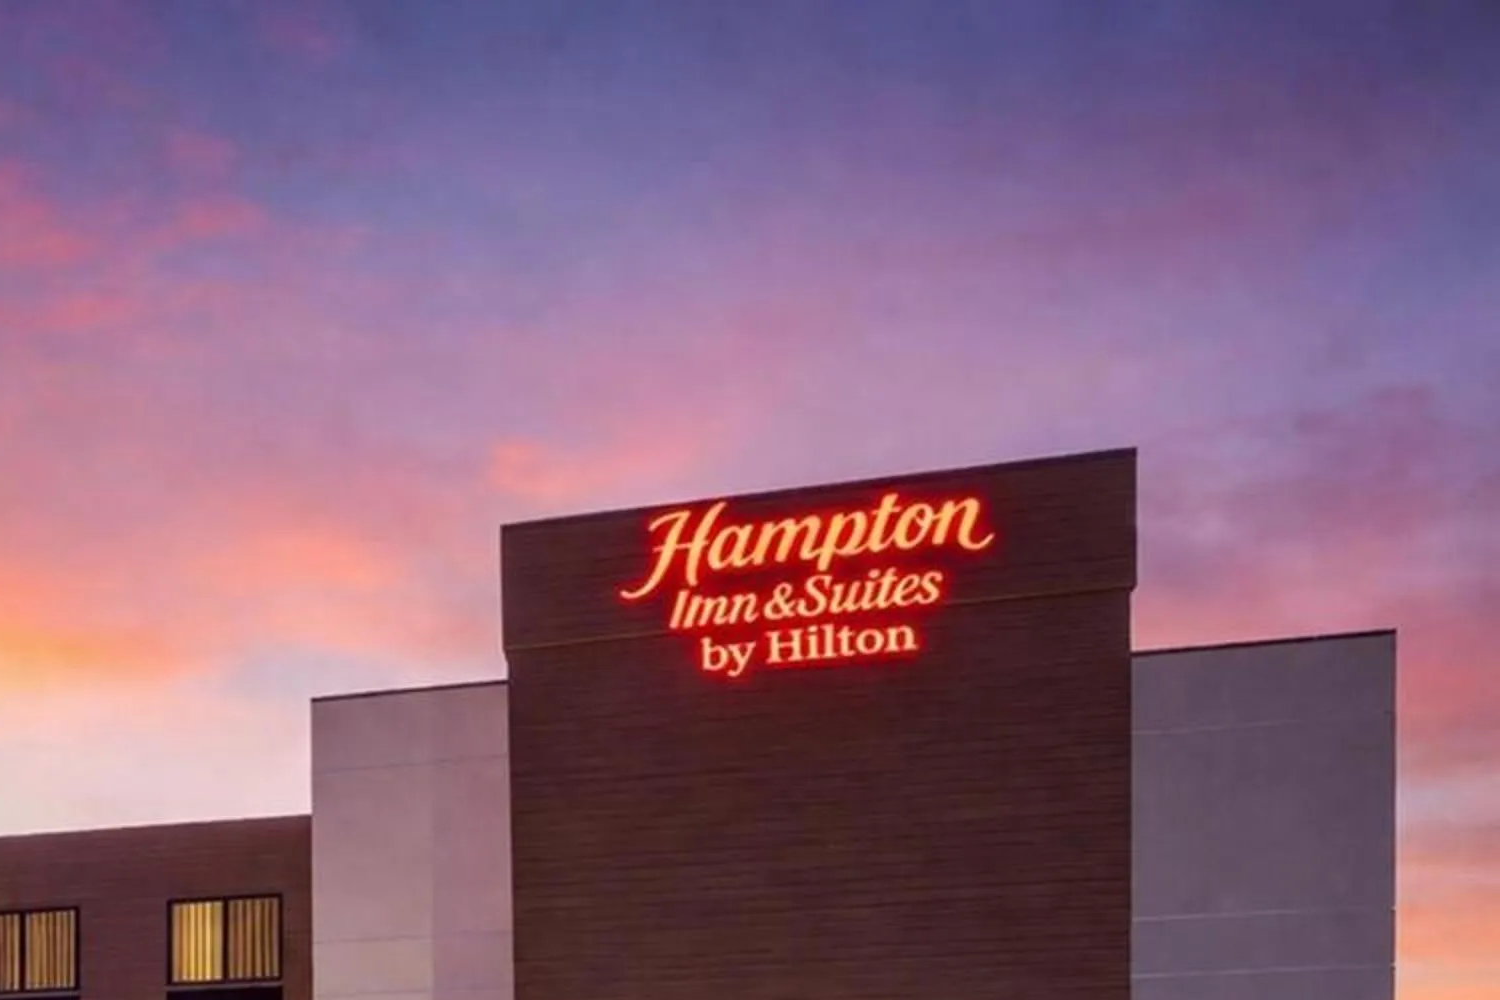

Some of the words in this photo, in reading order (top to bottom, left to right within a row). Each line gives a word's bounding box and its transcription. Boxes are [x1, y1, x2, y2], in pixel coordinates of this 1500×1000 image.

[620, 493, 996, 600] Hampton
[668, 590, 759, 629] Inn
[701, 637, 757, 678] by
[766, 624, 919, 665] Hilton
